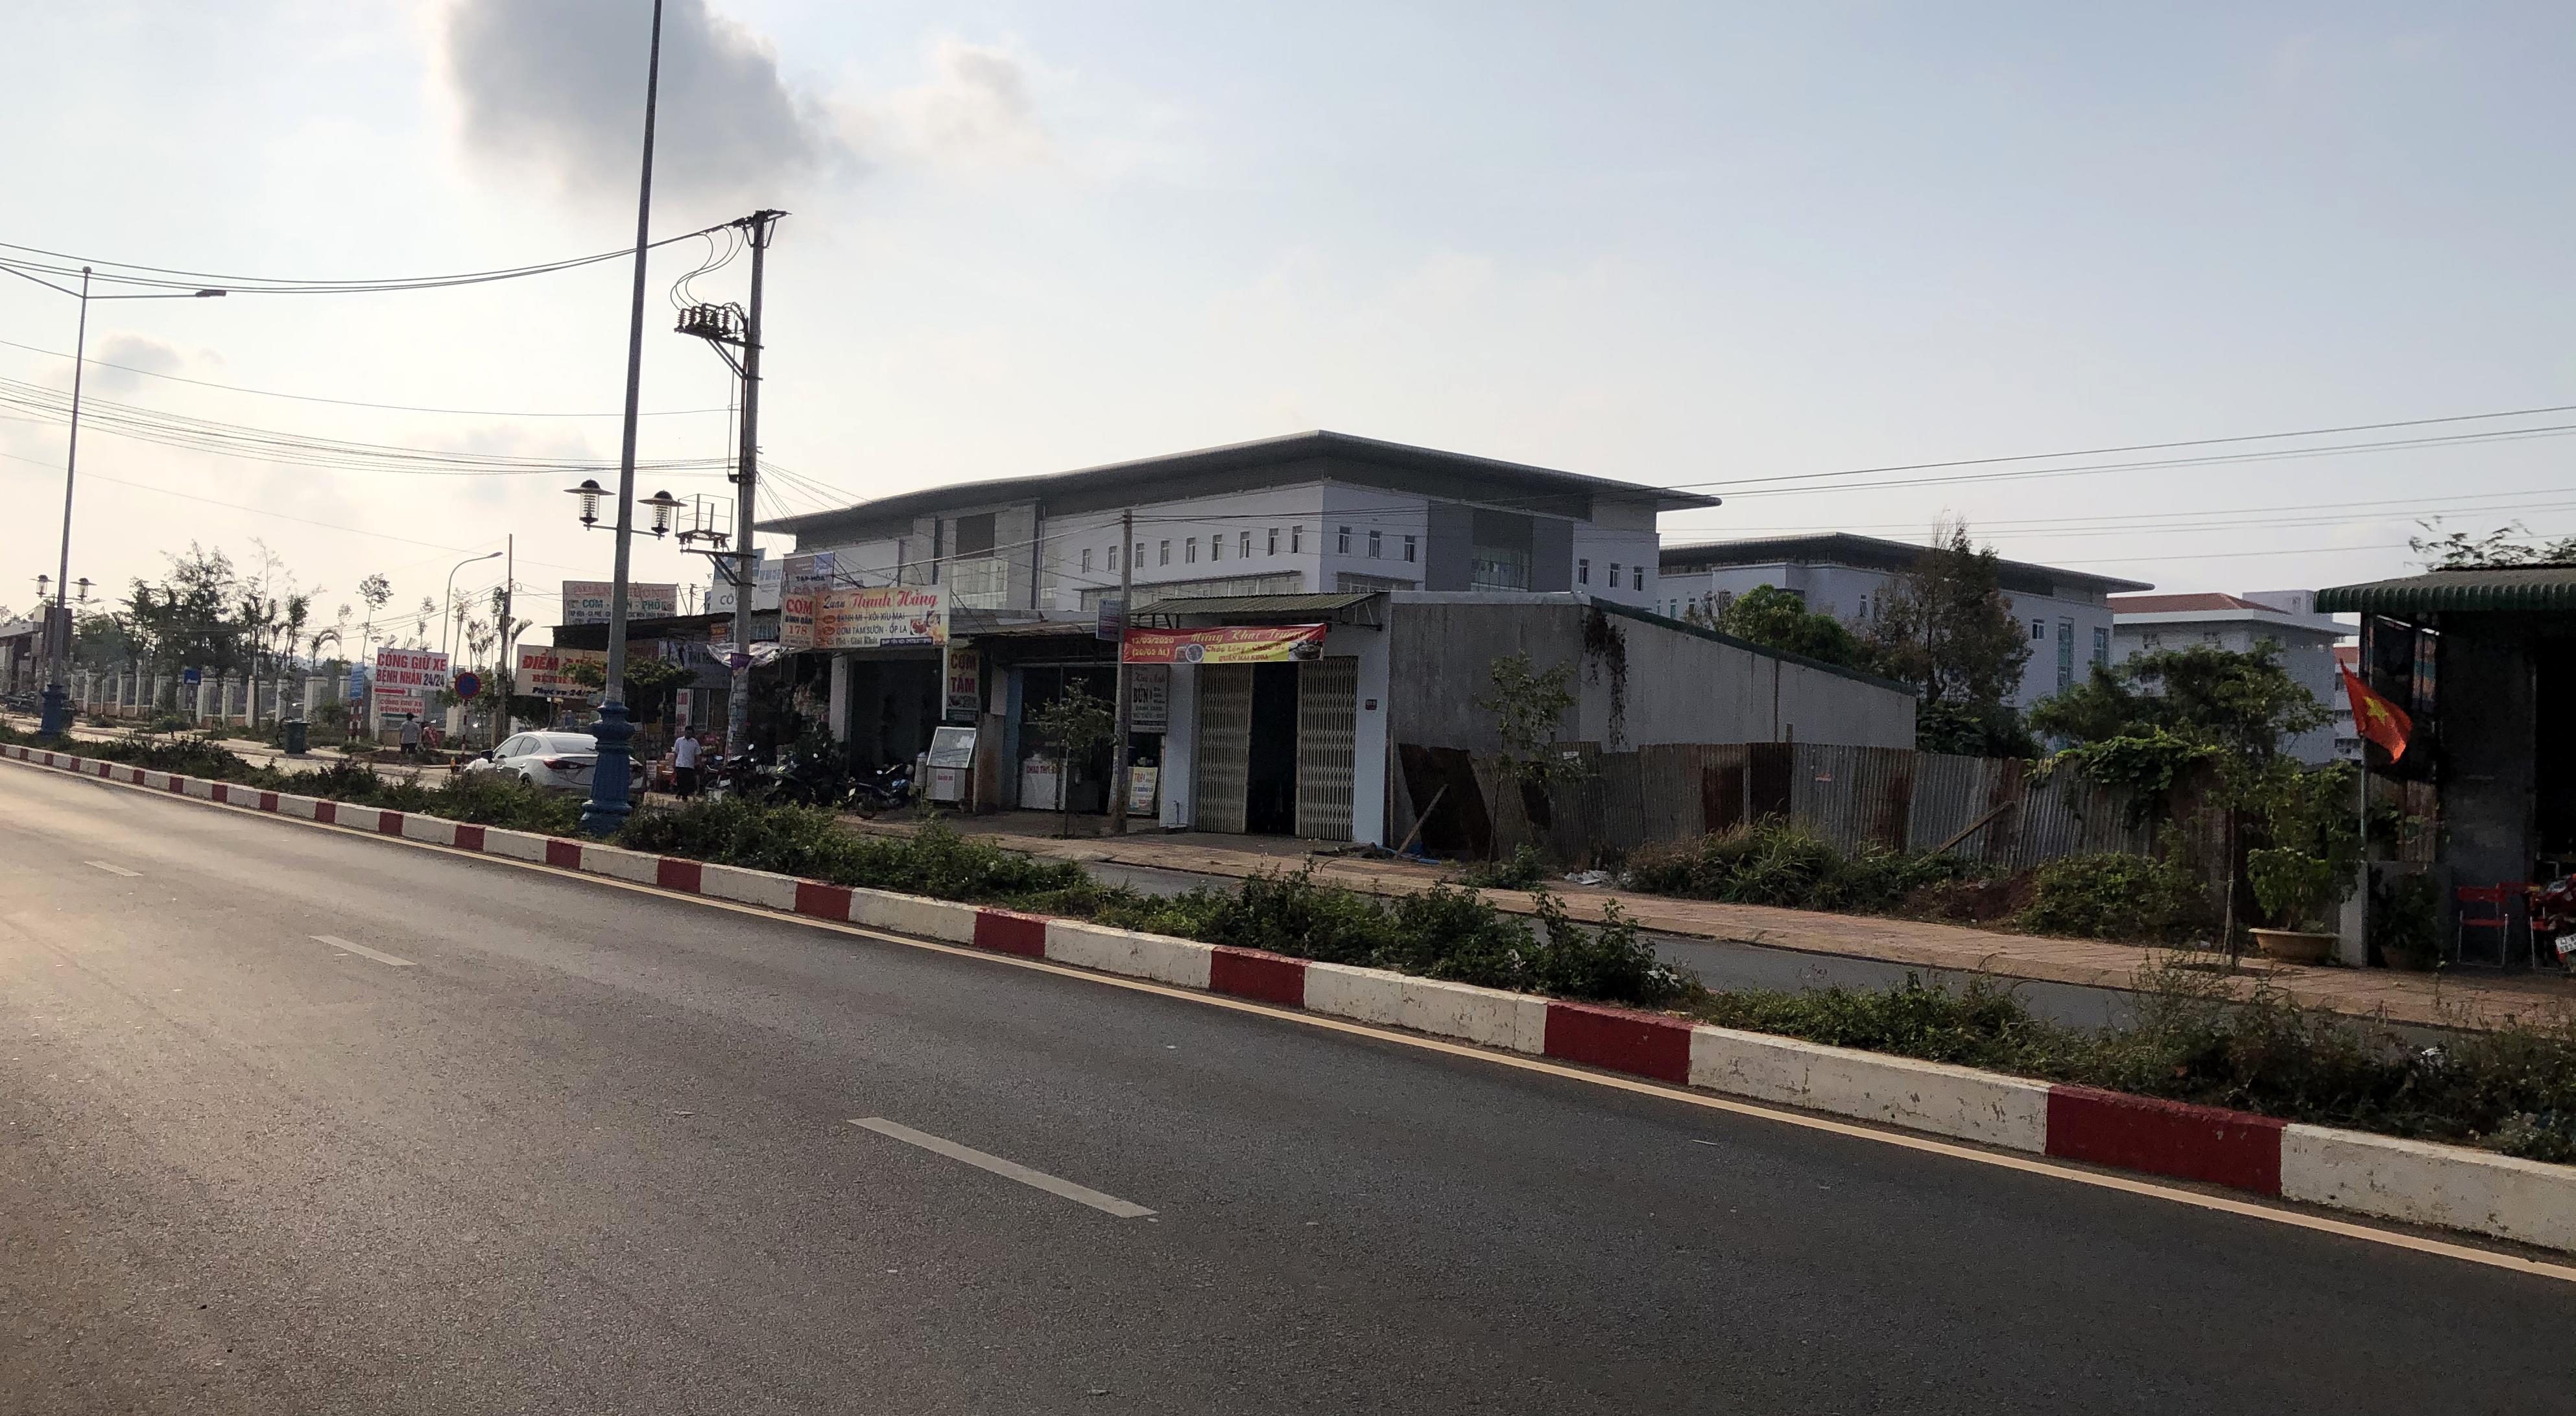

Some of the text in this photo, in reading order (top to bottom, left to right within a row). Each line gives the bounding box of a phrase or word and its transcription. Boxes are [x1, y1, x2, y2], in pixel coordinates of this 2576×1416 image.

[786, 597, 812, 615] CƠM
[851, 591, 892, 609] Thanh
[789, 625, 807, 635] 178
[433, 658, 446, 671] XE
[376, 667, 398, 685] BỆNH
[400, 669, 422, 685] NHÂN
[423, 673, 445, 687] 24/24
